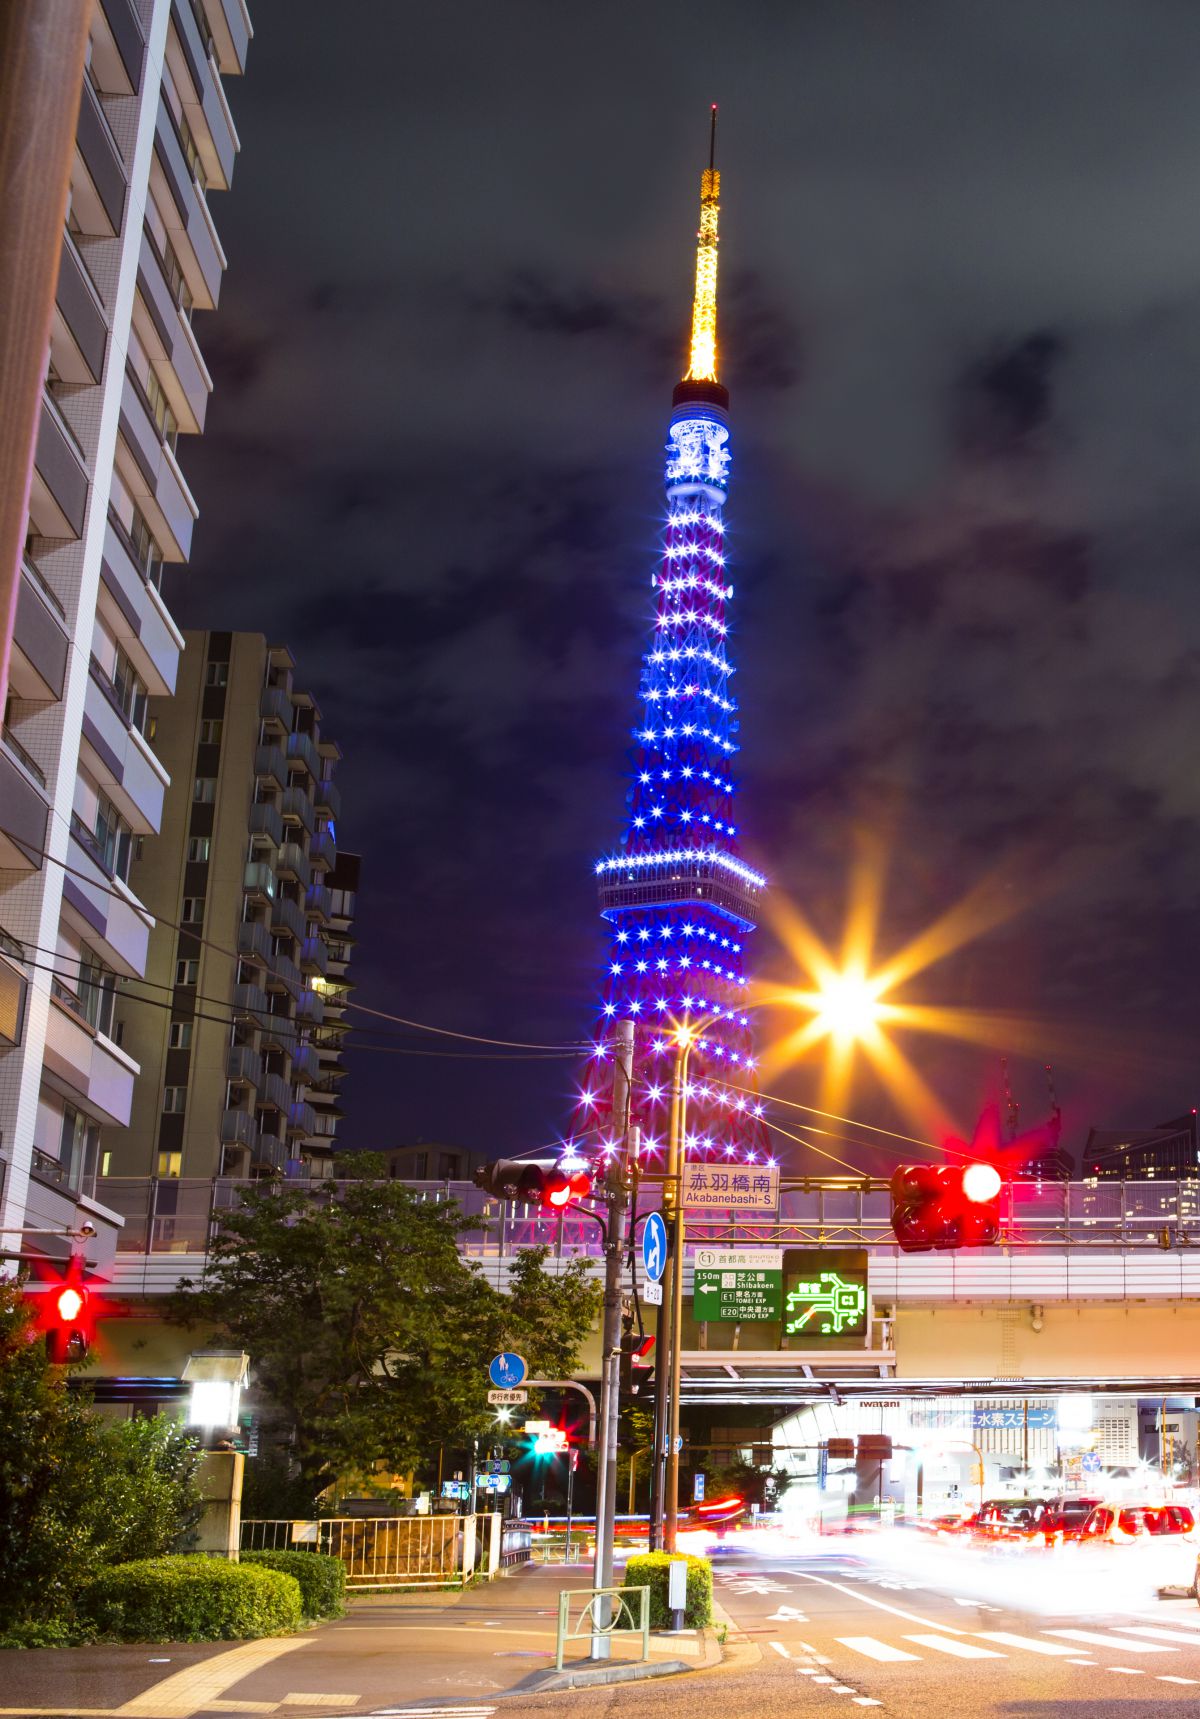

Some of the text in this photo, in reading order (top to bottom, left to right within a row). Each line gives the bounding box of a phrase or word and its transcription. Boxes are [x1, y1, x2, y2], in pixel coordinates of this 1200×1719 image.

[690, 1173, 771, 1193] 赤羽橋南
[686, 1192, 774, 1205] Akabanebashi-S.
[718, 1255, 746, 1264] 首都高
[696, 1272, 720, 1280] 150m
[737, 1272, 766, 1282] 芝公園
[841, 1295, 855, 1306] C1
[722, 1308, 737, 1316] E20
[786, 1323, 796, 1333] 3
[821, 1323, 831, 1333] 2
